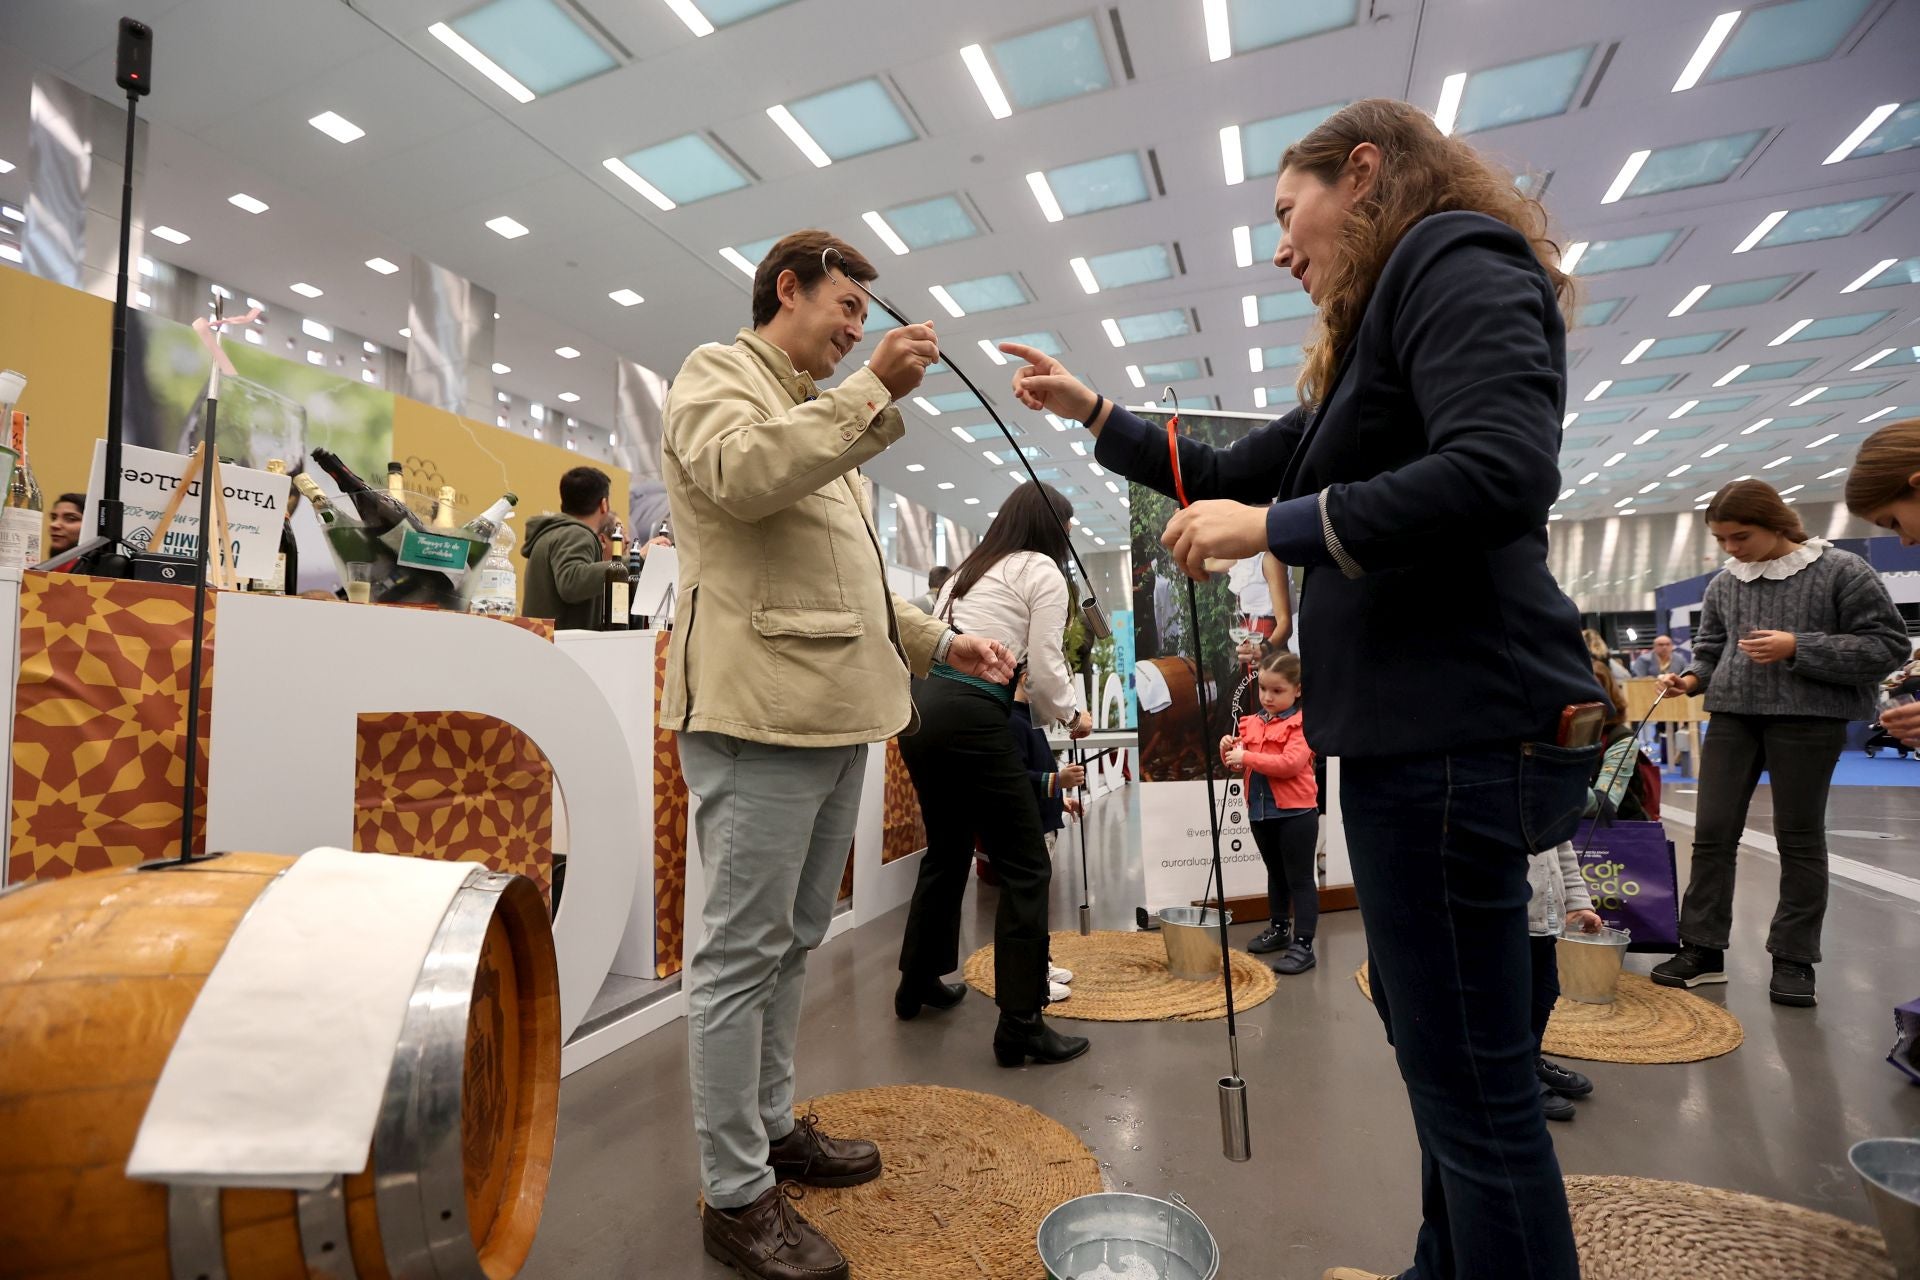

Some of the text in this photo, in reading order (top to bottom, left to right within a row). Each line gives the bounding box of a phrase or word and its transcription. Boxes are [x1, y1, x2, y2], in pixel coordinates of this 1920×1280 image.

[120, 467, 276, 510] Vino Dulce
[122, 504, 144, 517] 202
[1228, 798, 1243, 807] 898
[1161, 852, 1262, 868] auroraluqucordoba@
